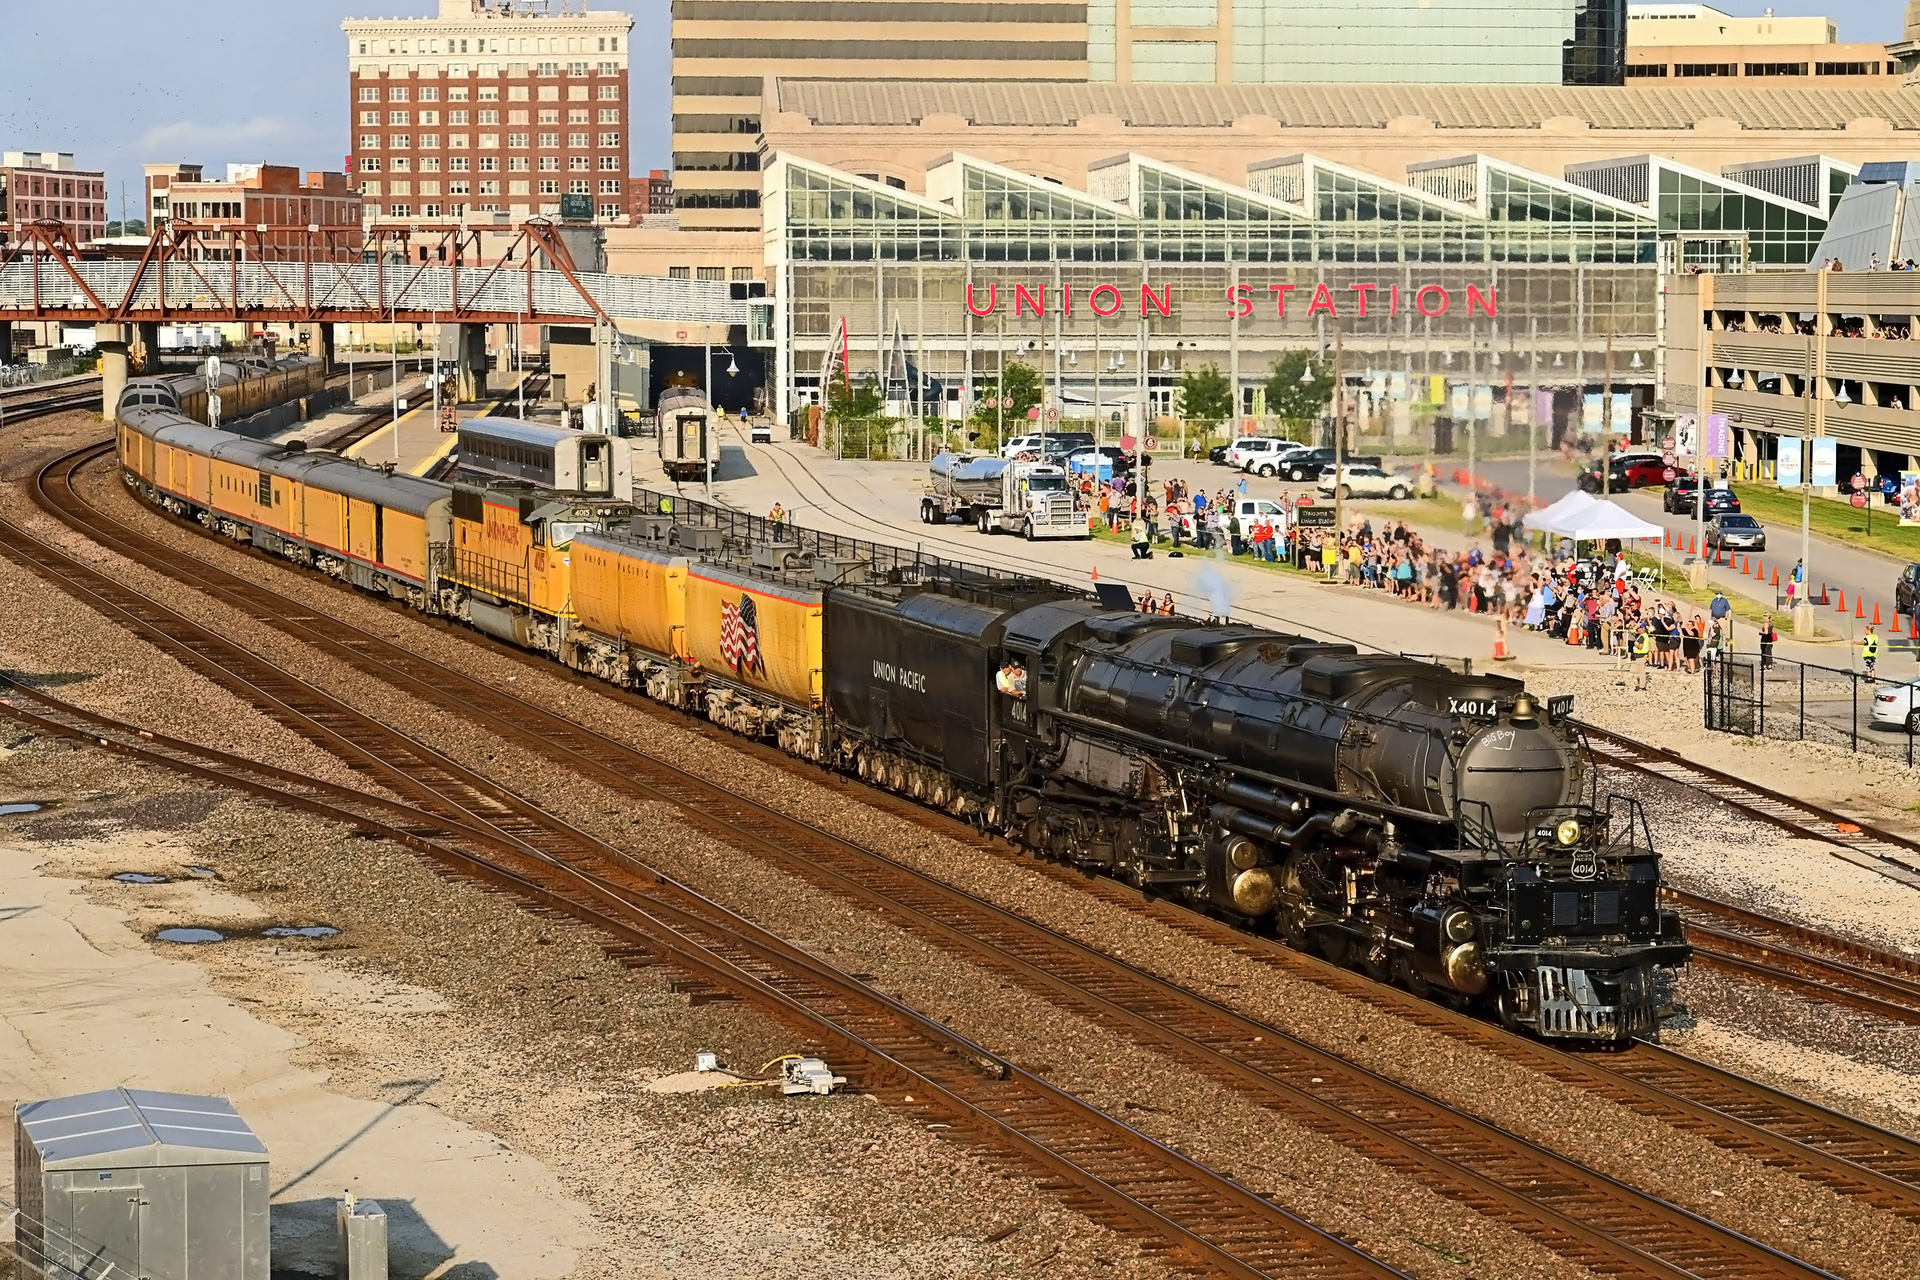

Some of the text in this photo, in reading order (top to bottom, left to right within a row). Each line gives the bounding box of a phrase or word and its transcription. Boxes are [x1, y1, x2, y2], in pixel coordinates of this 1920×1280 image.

[967, 283, 1499, 319] UNION STATION
[1717, 417, 1727, 455] IMAGINE
[574, 508, 590, 517] 4015
[584, 552, 649, 579] UNION PACIFIC
[873, 659, 926, 694] UNION PACIFIC
[1011, 701, 1027, 722] 4014
[1449, 699, 1497, 717] X4014
[1552, 697, 1574, 716] X4014
[1536, 829, 1552, 837] 4014
[1573, 864, 1594, 874] 4014
